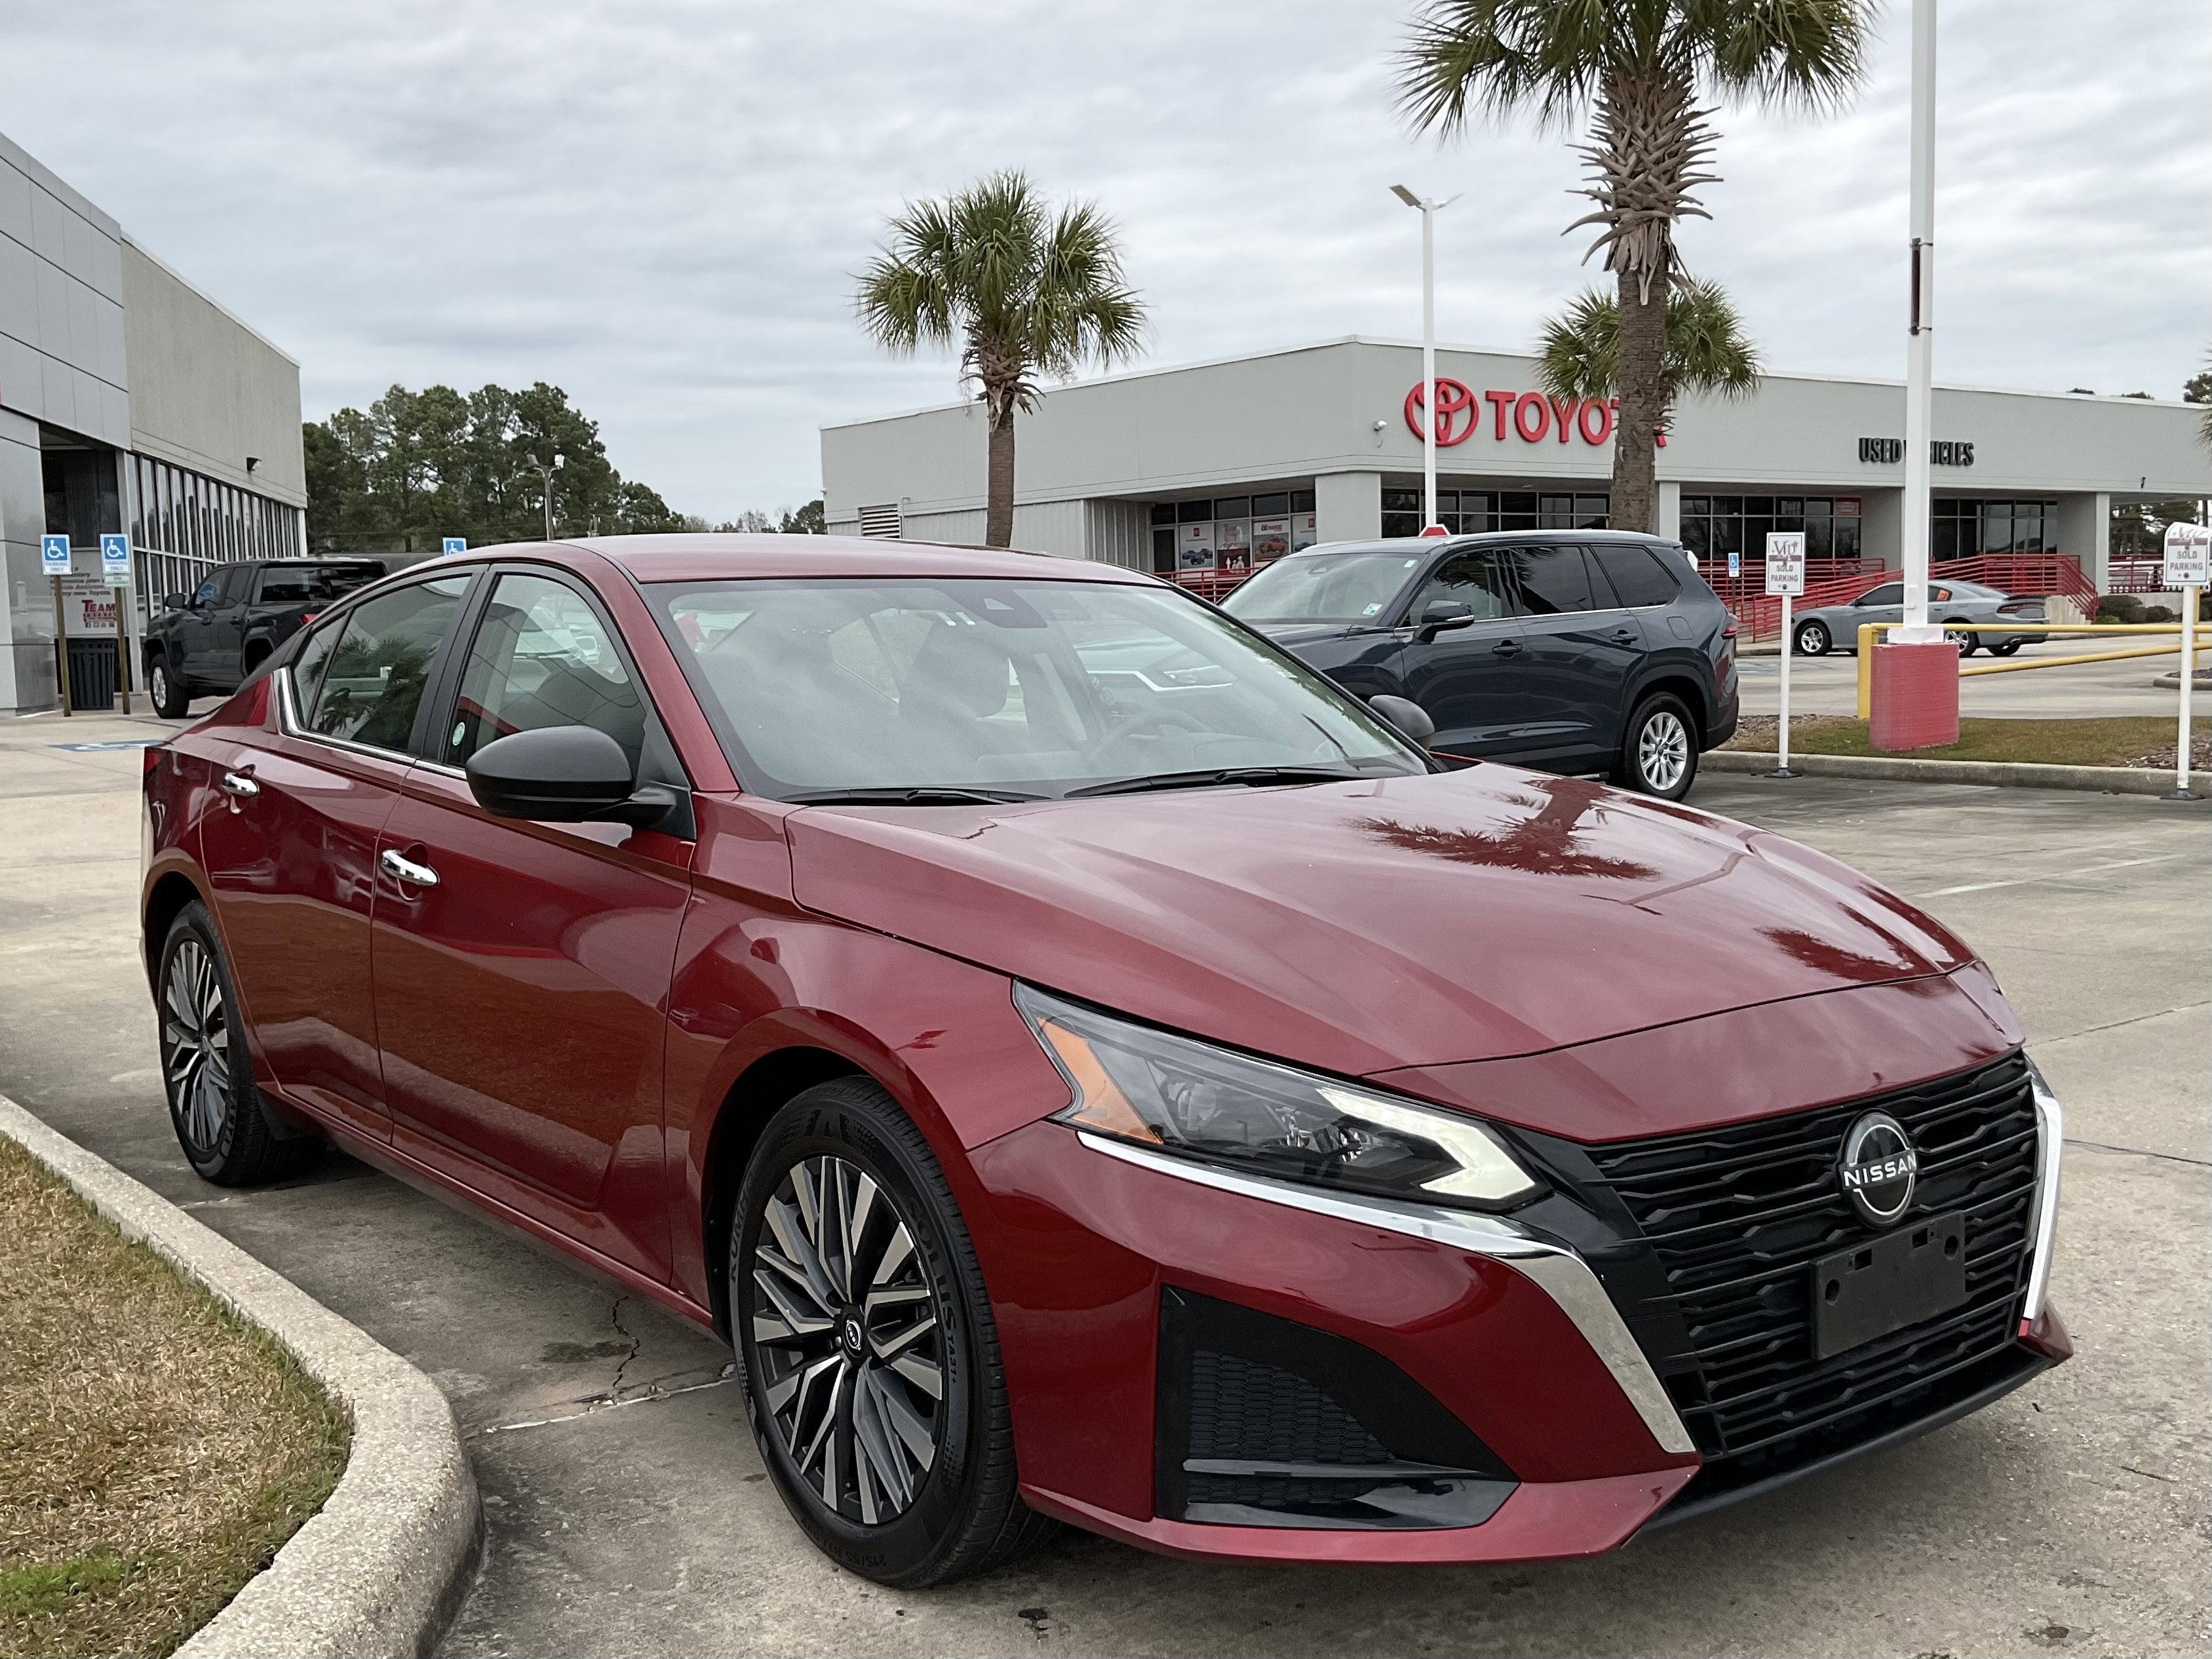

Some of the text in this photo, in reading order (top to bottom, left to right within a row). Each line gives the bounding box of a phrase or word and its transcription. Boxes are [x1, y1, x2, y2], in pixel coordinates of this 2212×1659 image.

[1485, 391, 1666, 447] TOYO
[1859, 437, 1902, 463] USED
[81, 600, 115, 612] TEAM
[1844, 1152, 1917, 1187] NISSAN
